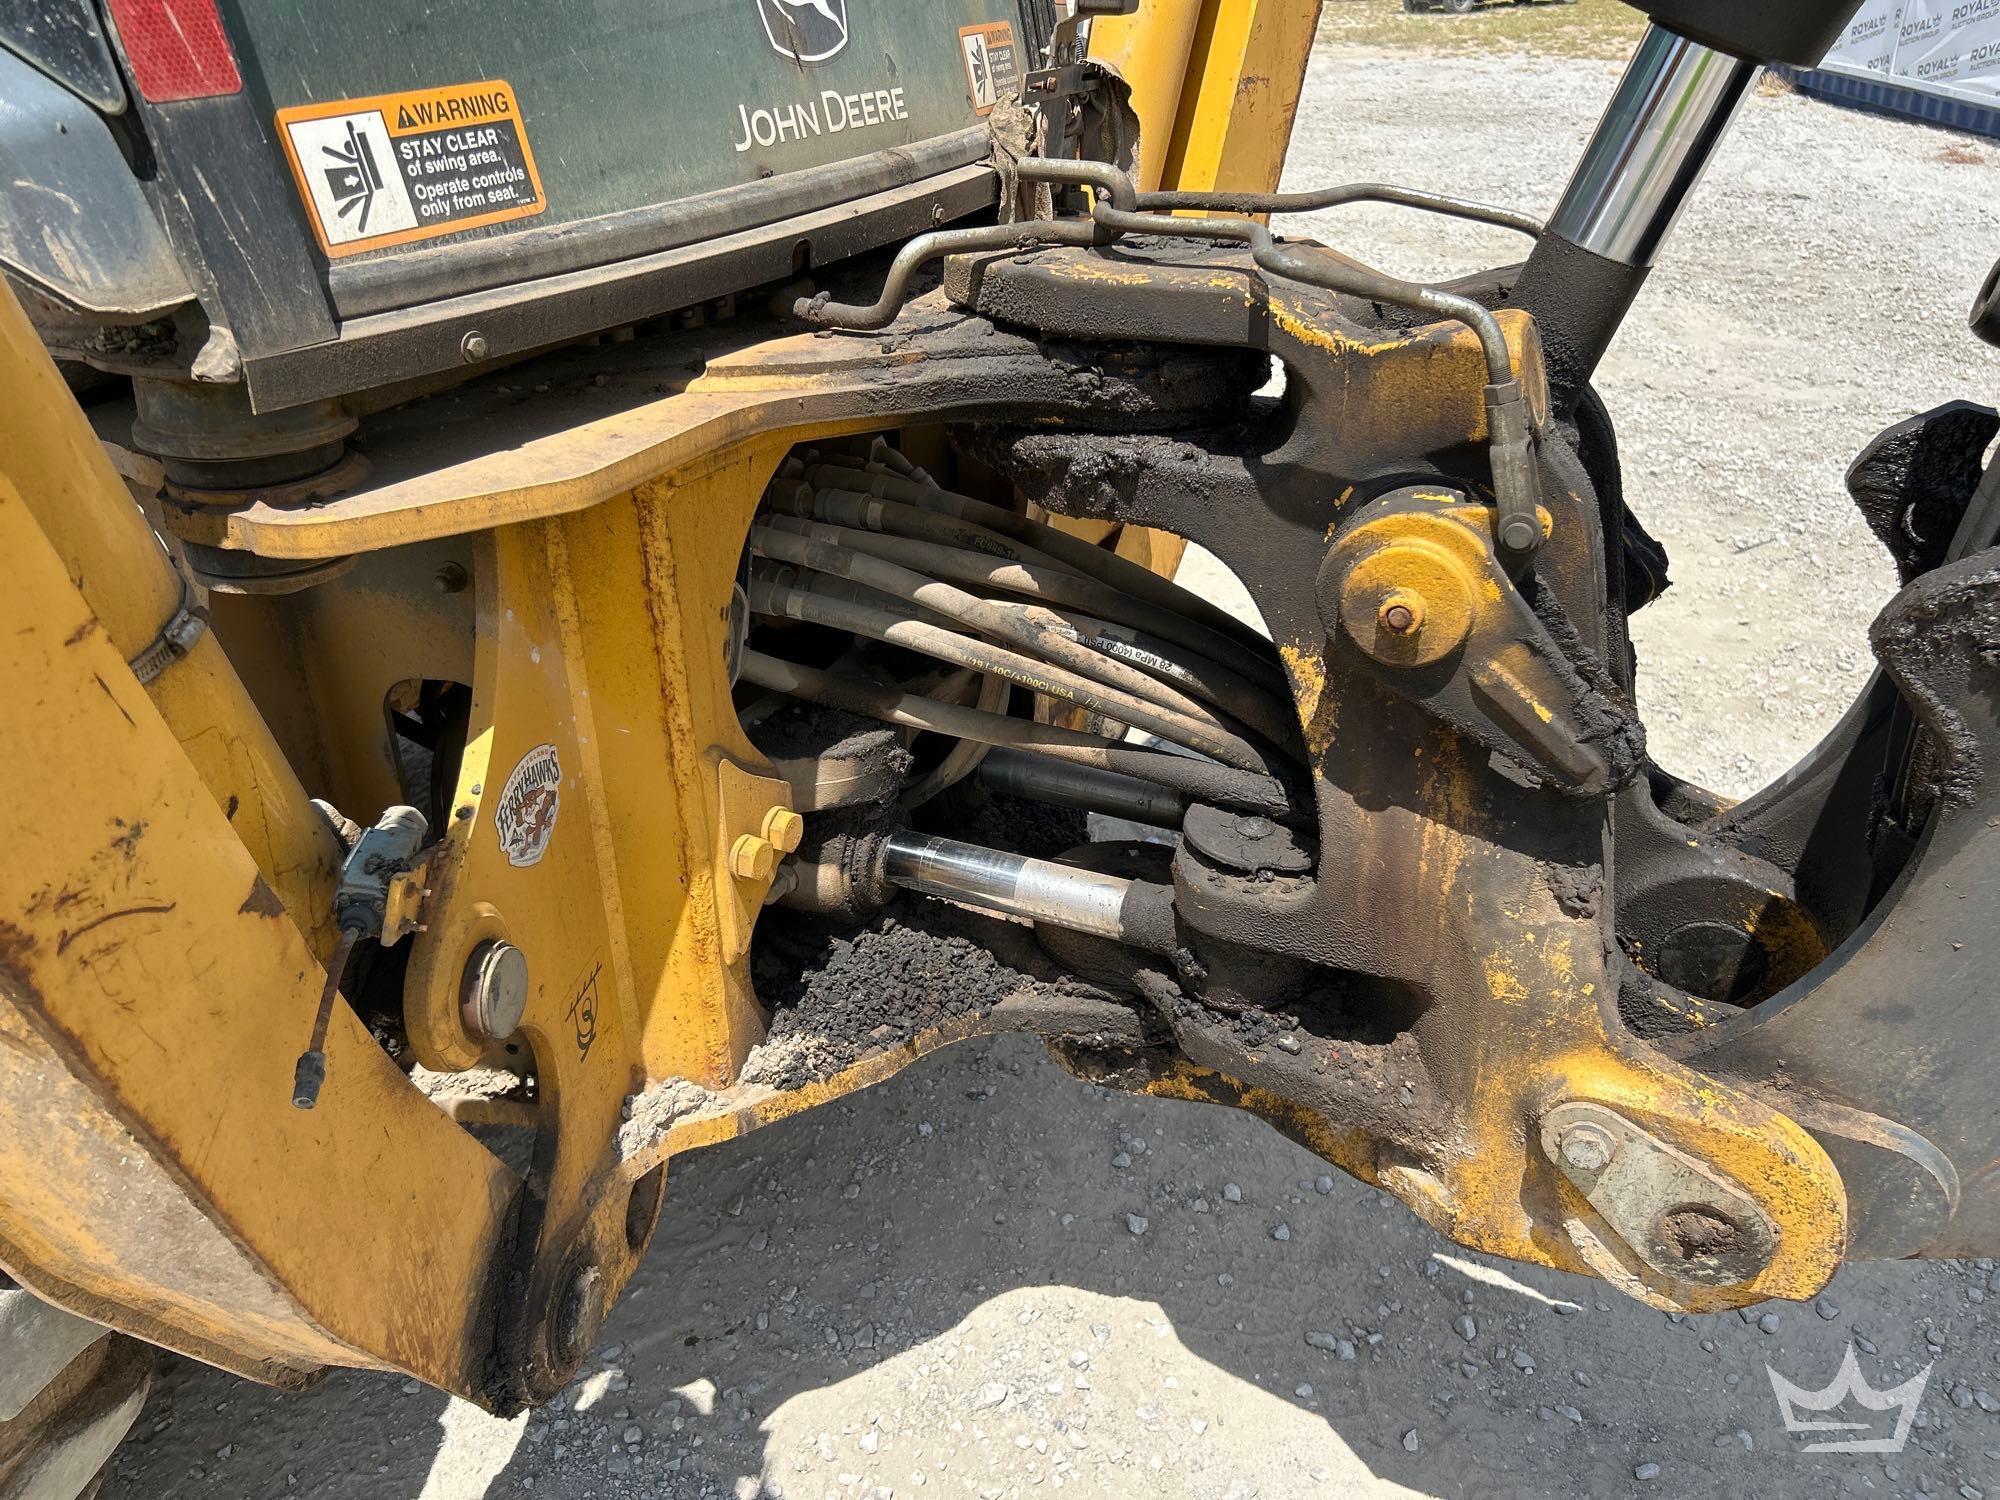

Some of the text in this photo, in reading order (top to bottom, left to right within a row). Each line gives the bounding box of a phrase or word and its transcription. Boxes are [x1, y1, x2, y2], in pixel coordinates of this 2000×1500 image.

[1952, 0, 1989, 21] ROYAL
[1851, 17, 1879, 37] ROYAL
[1900, 19, 1932, 38] ROYAL
[1969, 42, 2000, 62] ROYA
[1867, 54, 1890, 71] ROYA
[1917, 57, 1950, 76] ROYAL
[413, 92, 510, 125] WARNING
[734, 87, 909, 152] JOHN DEERE
[400, 129, 499, 160] STAY CLEAR
[407, 151, 501, 177] of swing area.
[415, 167, 525, 202] Operate controls
[421, 184, 519, 218] only from seat.
[1107, 641, 1133, 657] (4000
[1135, 651, 1158, 667] MPa
[1158, 659, 1172, 672] 28
[1051, 686, 1074, 700] USA
[497, 750, 560, 847] FERRYHAWKS
